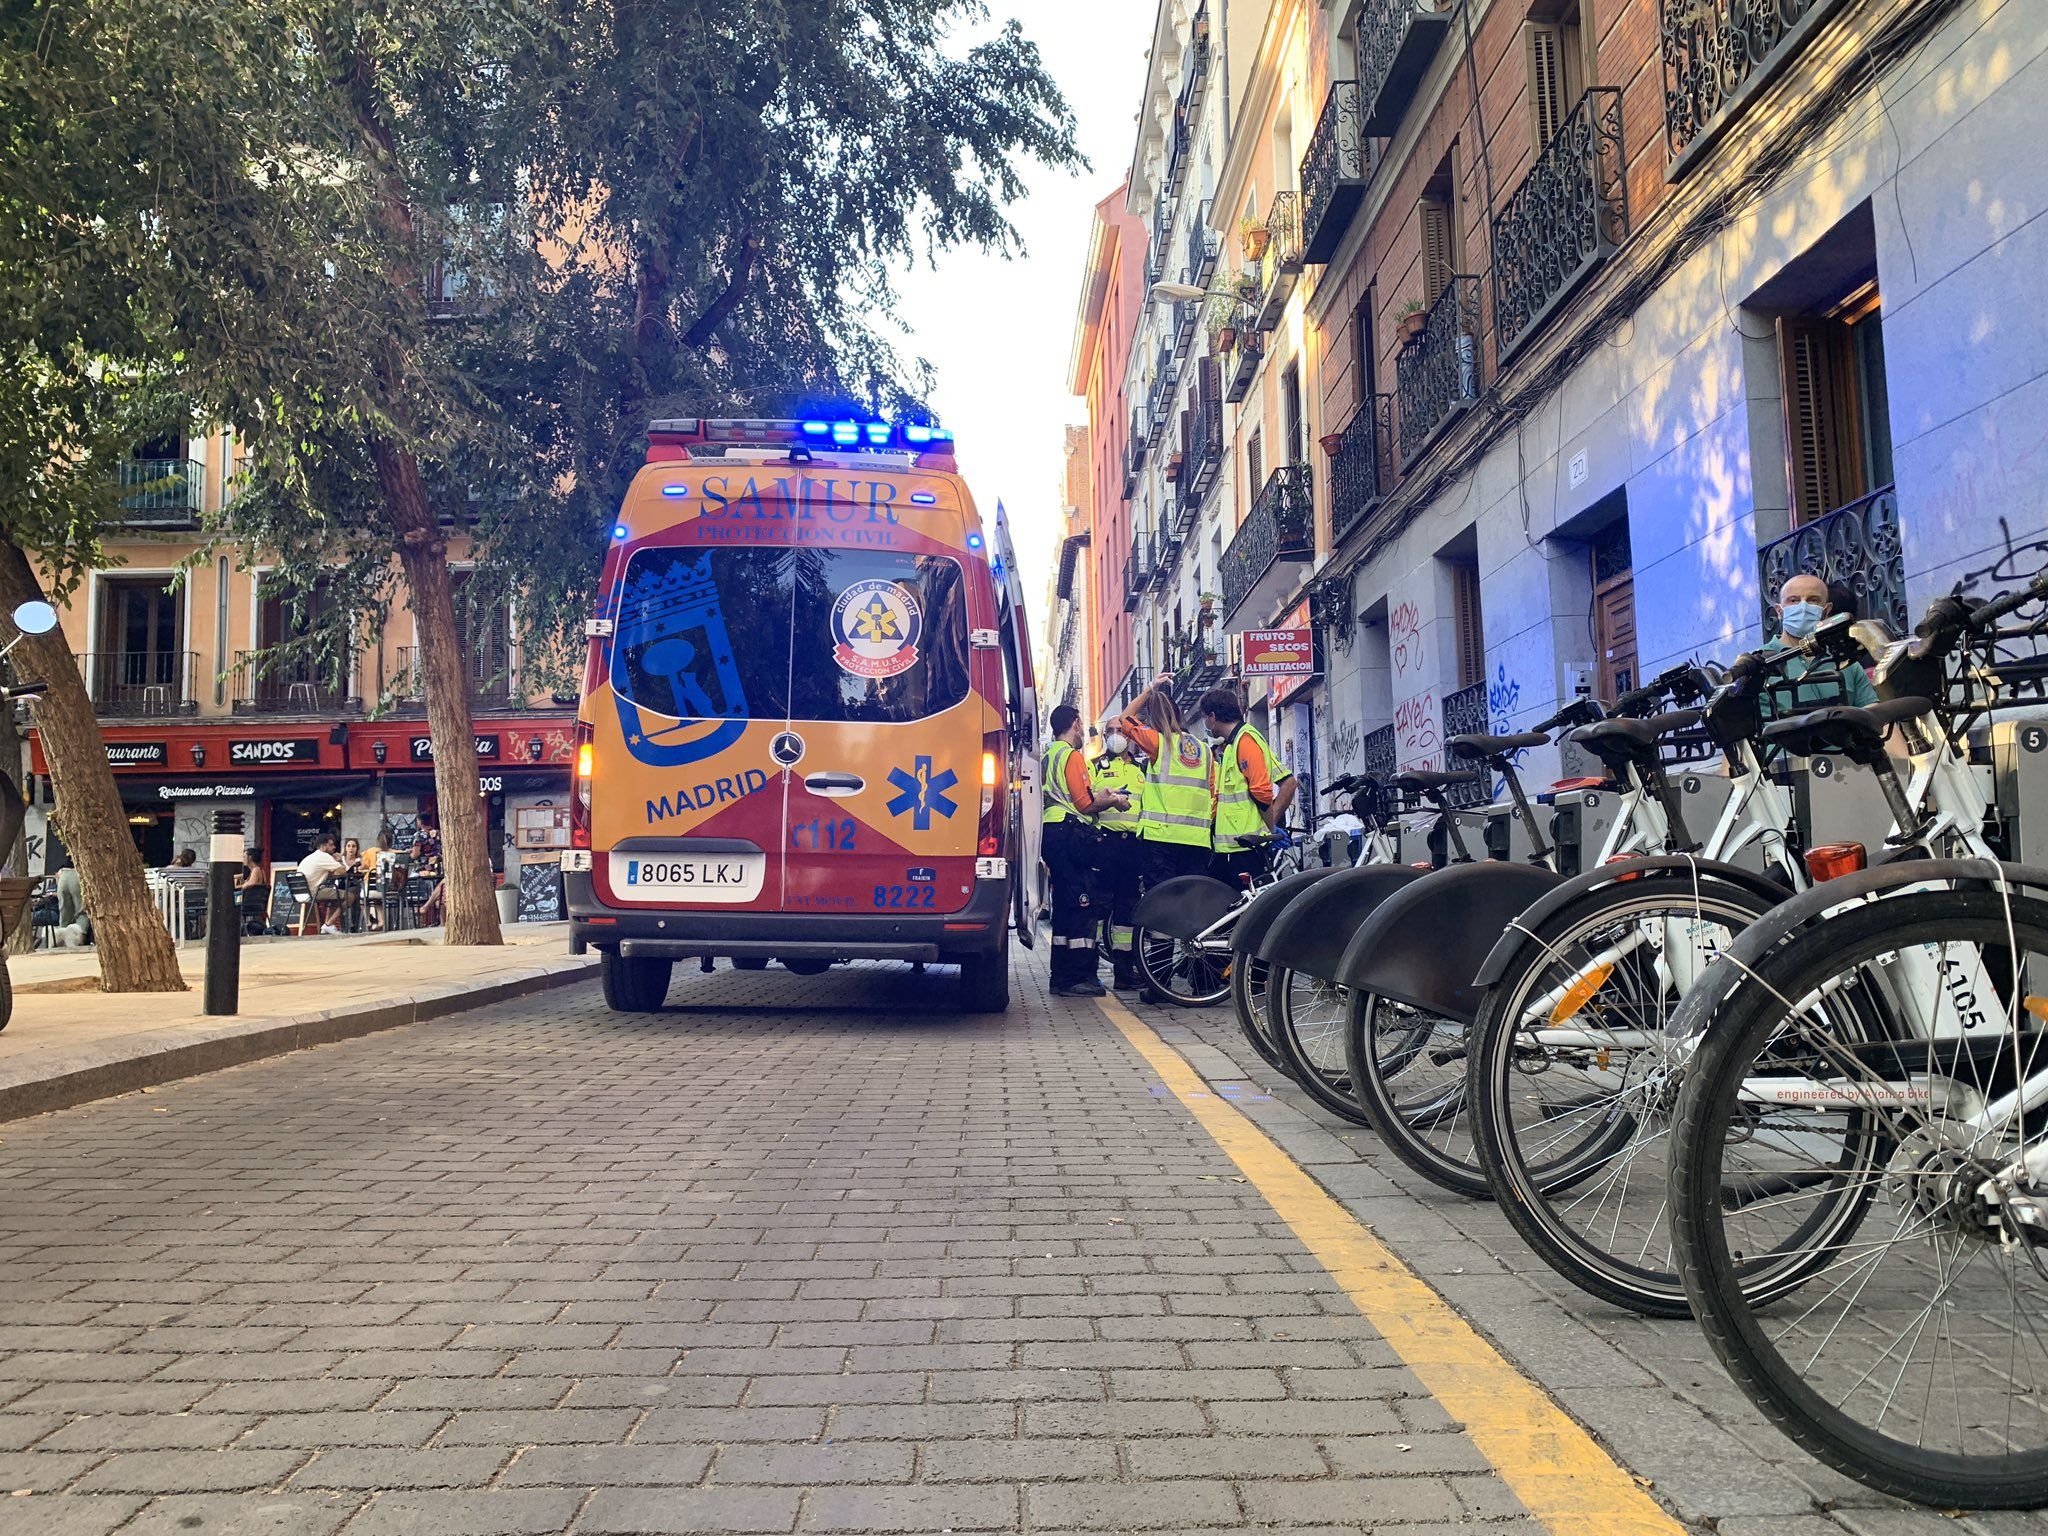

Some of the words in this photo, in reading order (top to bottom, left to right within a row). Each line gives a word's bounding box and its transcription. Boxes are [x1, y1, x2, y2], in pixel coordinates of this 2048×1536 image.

[700, 476, 899, 525] SAMUR
[841, 528, 898, 545] CIVIL
[837, 585, 865, 614] ciudad
[887, 586, 918, 616] madrid
[1250, 632, 1295, 641] FRUTOS
[1269, 643, 1309, 652] SECOS
[840, 656, 890, 675] PROTECCION
[892, 658, 912, 672] CIVIL
[1246, 662, 1311, 672] ALIMENTACION
[2029, 732, 2040, 747] 5
[105, 745, 161, 759] aurante
[232, 742, 295, 759] SANDOS
[1818, 761, 1827, 774] 6
[1688, 780, 1695, 790] 7
[159, 786, 214, 799] Restaurante
[646, 768, 767, 824] MADRID
[1588, 796, 1595, 806] 8
[642, 864, 695, 883] 8065
[703, 864, 744, 883] LKJ
[873, 886, 936, 908] 8222
[1646, 923, 1653, 934] 7
[1937, 960, 1986, 1029] 6105
[1777, 1089, 1843, 1101] engineered
[1848, 1088, 1860, 1101] by
